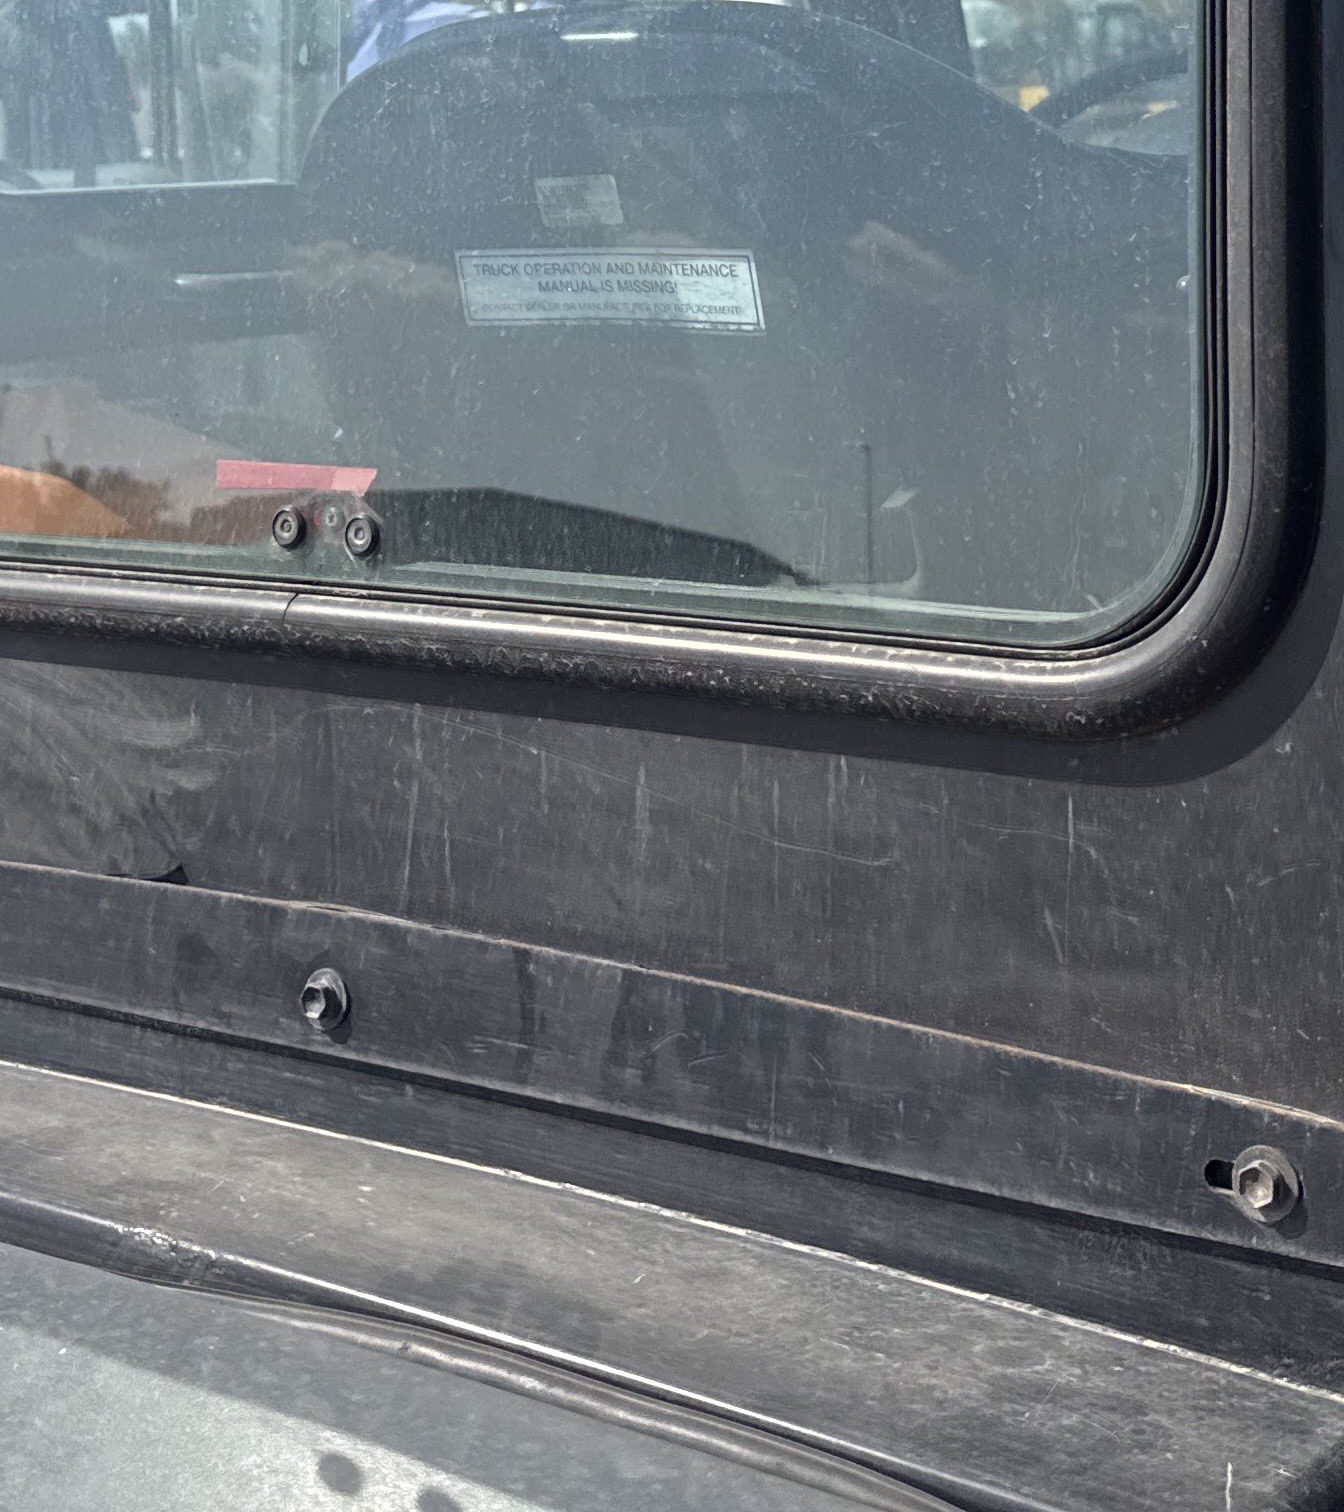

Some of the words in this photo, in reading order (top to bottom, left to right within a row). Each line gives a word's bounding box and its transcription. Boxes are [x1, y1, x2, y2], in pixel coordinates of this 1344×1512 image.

[473, 262, 521, 277] TRUCK
[523, 262, 602, 276] OPERATION
[606, 262, 635, 276] AND
[637, 261, 739, 278] MAINTENANCE
[537, 279, 598, 293] MANUAL
[600, 279, 614, 293] IS
